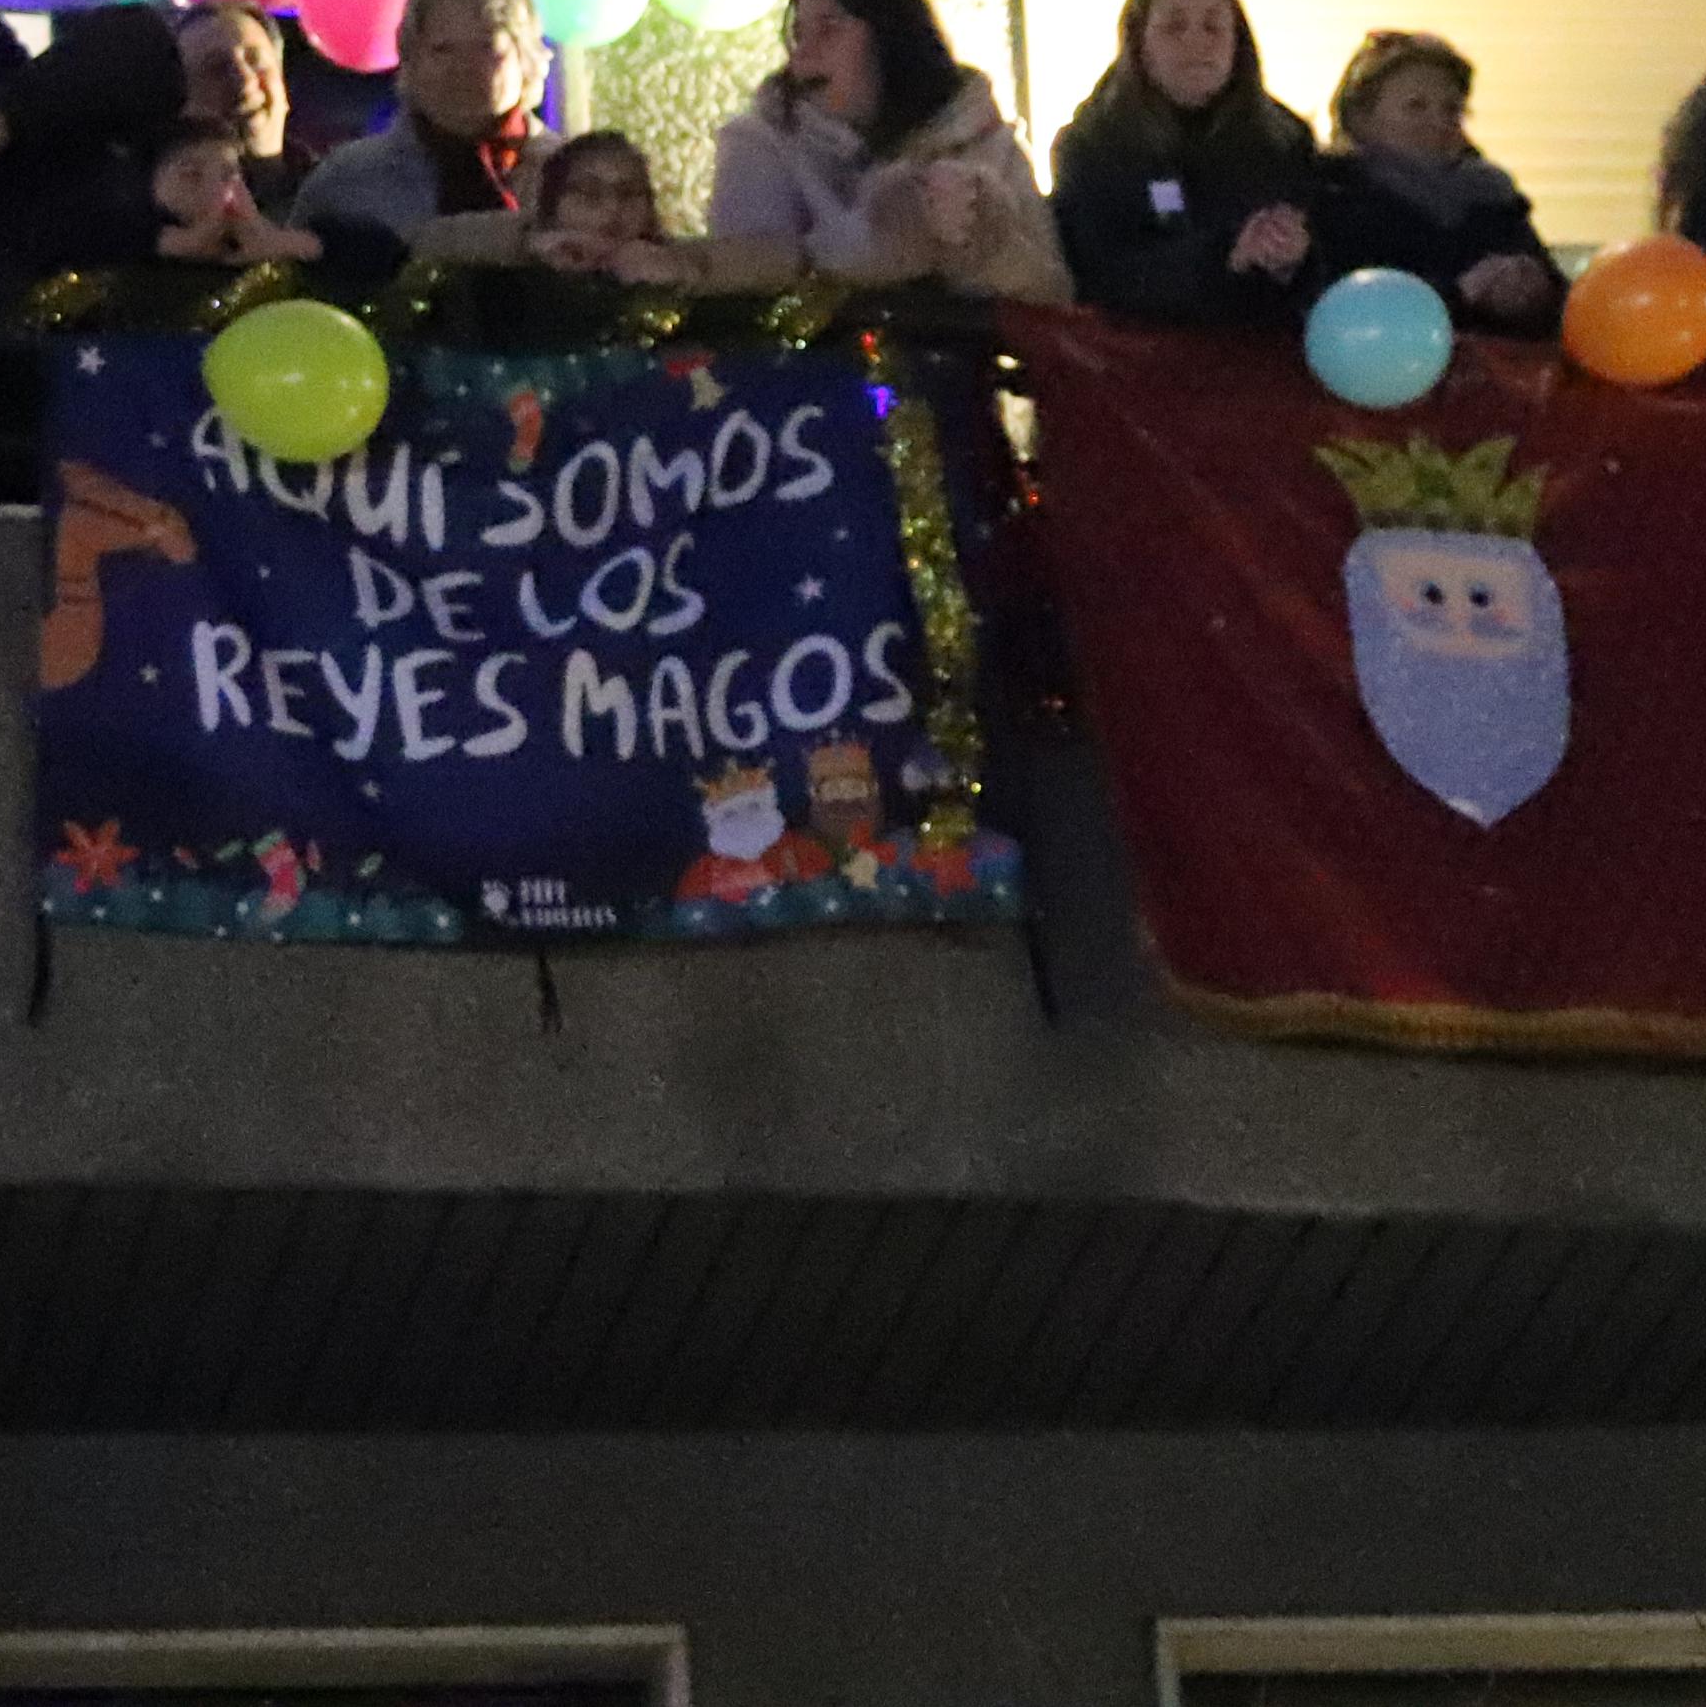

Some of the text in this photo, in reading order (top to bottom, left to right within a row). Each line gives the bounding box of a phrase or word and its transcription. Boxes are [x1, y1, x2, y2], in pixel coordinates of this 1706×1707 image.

[350, 533, 706, 643] DE LOS
[192, 621, 915, 763] REYES MAGOS
